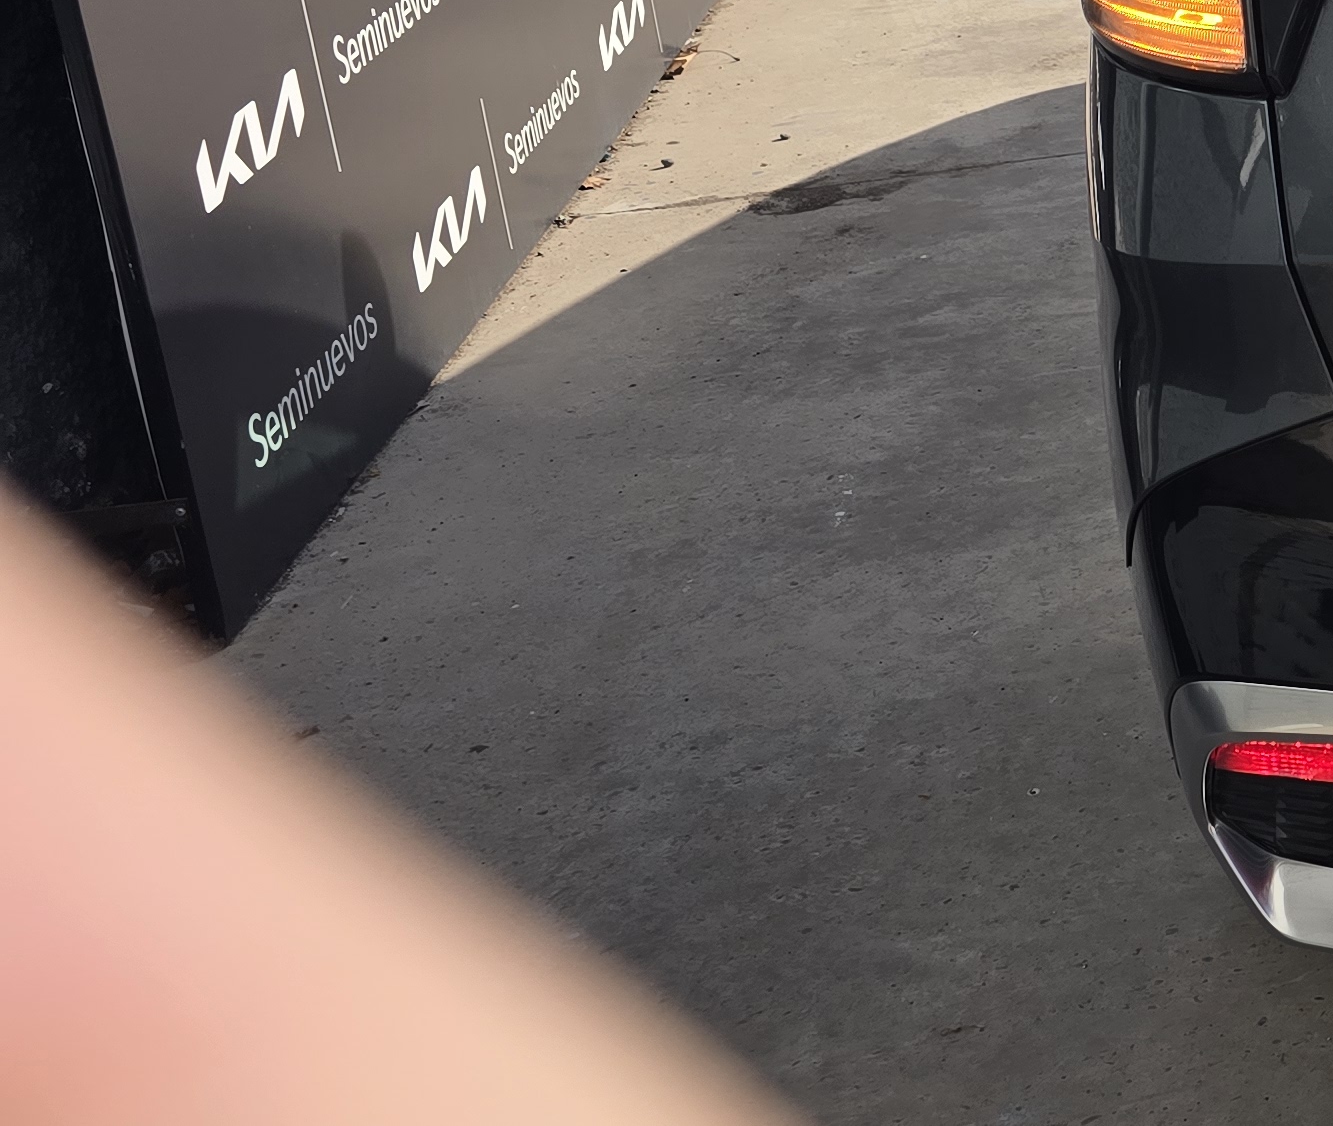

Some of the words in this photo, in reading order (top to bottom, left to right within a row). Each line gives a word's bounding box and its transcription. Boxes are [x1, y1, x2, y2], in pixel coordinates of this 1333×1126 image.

[196, 69, 304, 213] KIA
[413, 166, 486, 292] KIA
[505, 70, 579, 174] Seminuevos
[248, 303, 377, 467] Seminuevos
